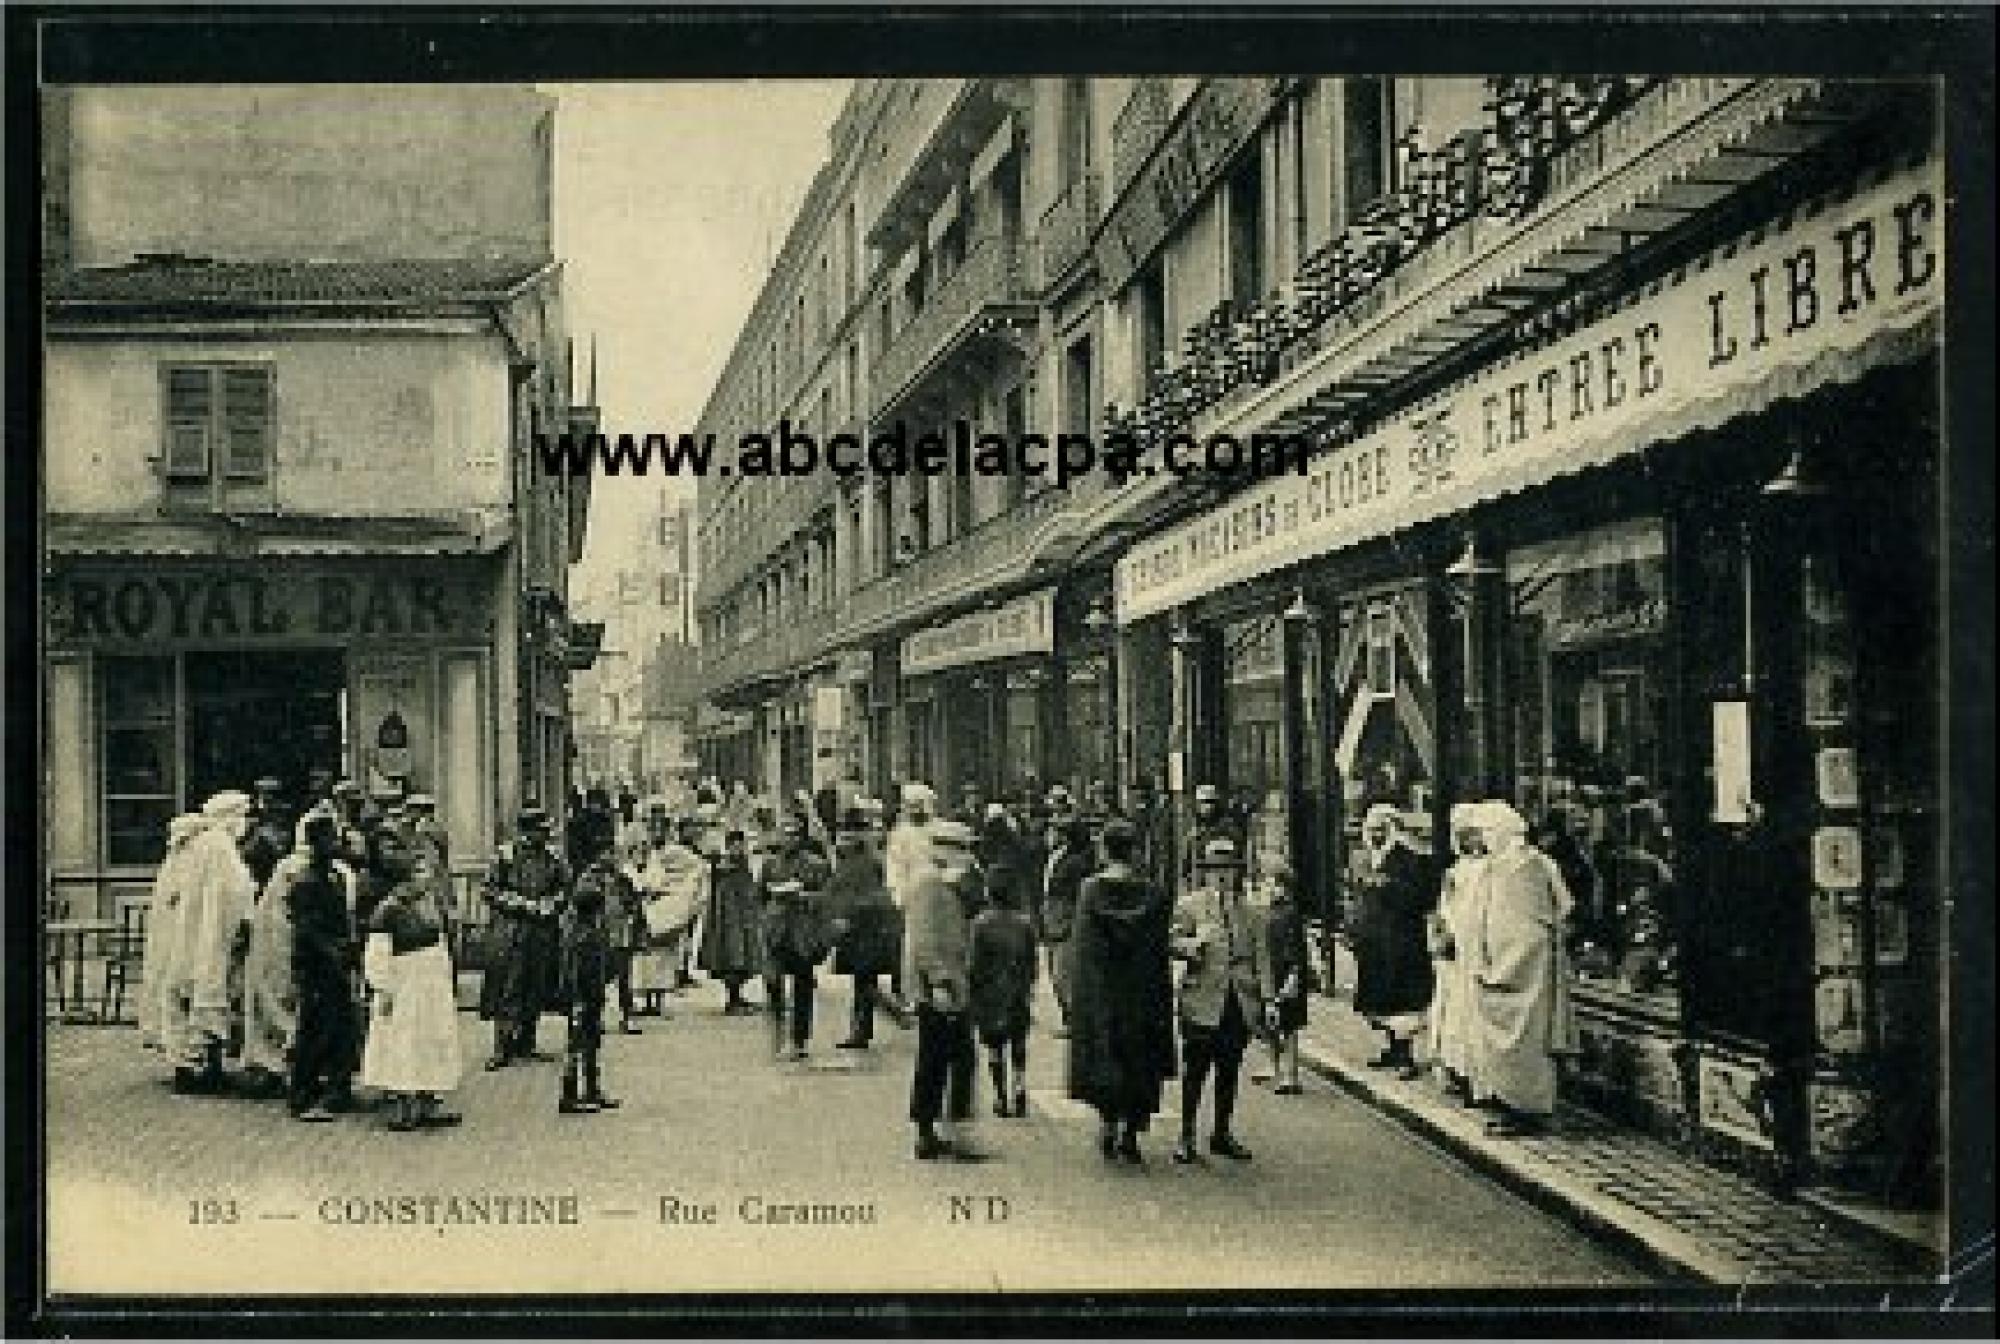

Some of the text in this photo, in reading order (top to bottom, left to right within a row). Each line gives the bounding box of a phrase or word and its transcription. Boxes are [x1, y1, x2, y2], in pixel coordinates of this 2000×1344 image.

[1708, 193, 1937, 369] LIBRE
[72, 577, 452, 638] ROYAL BAR
